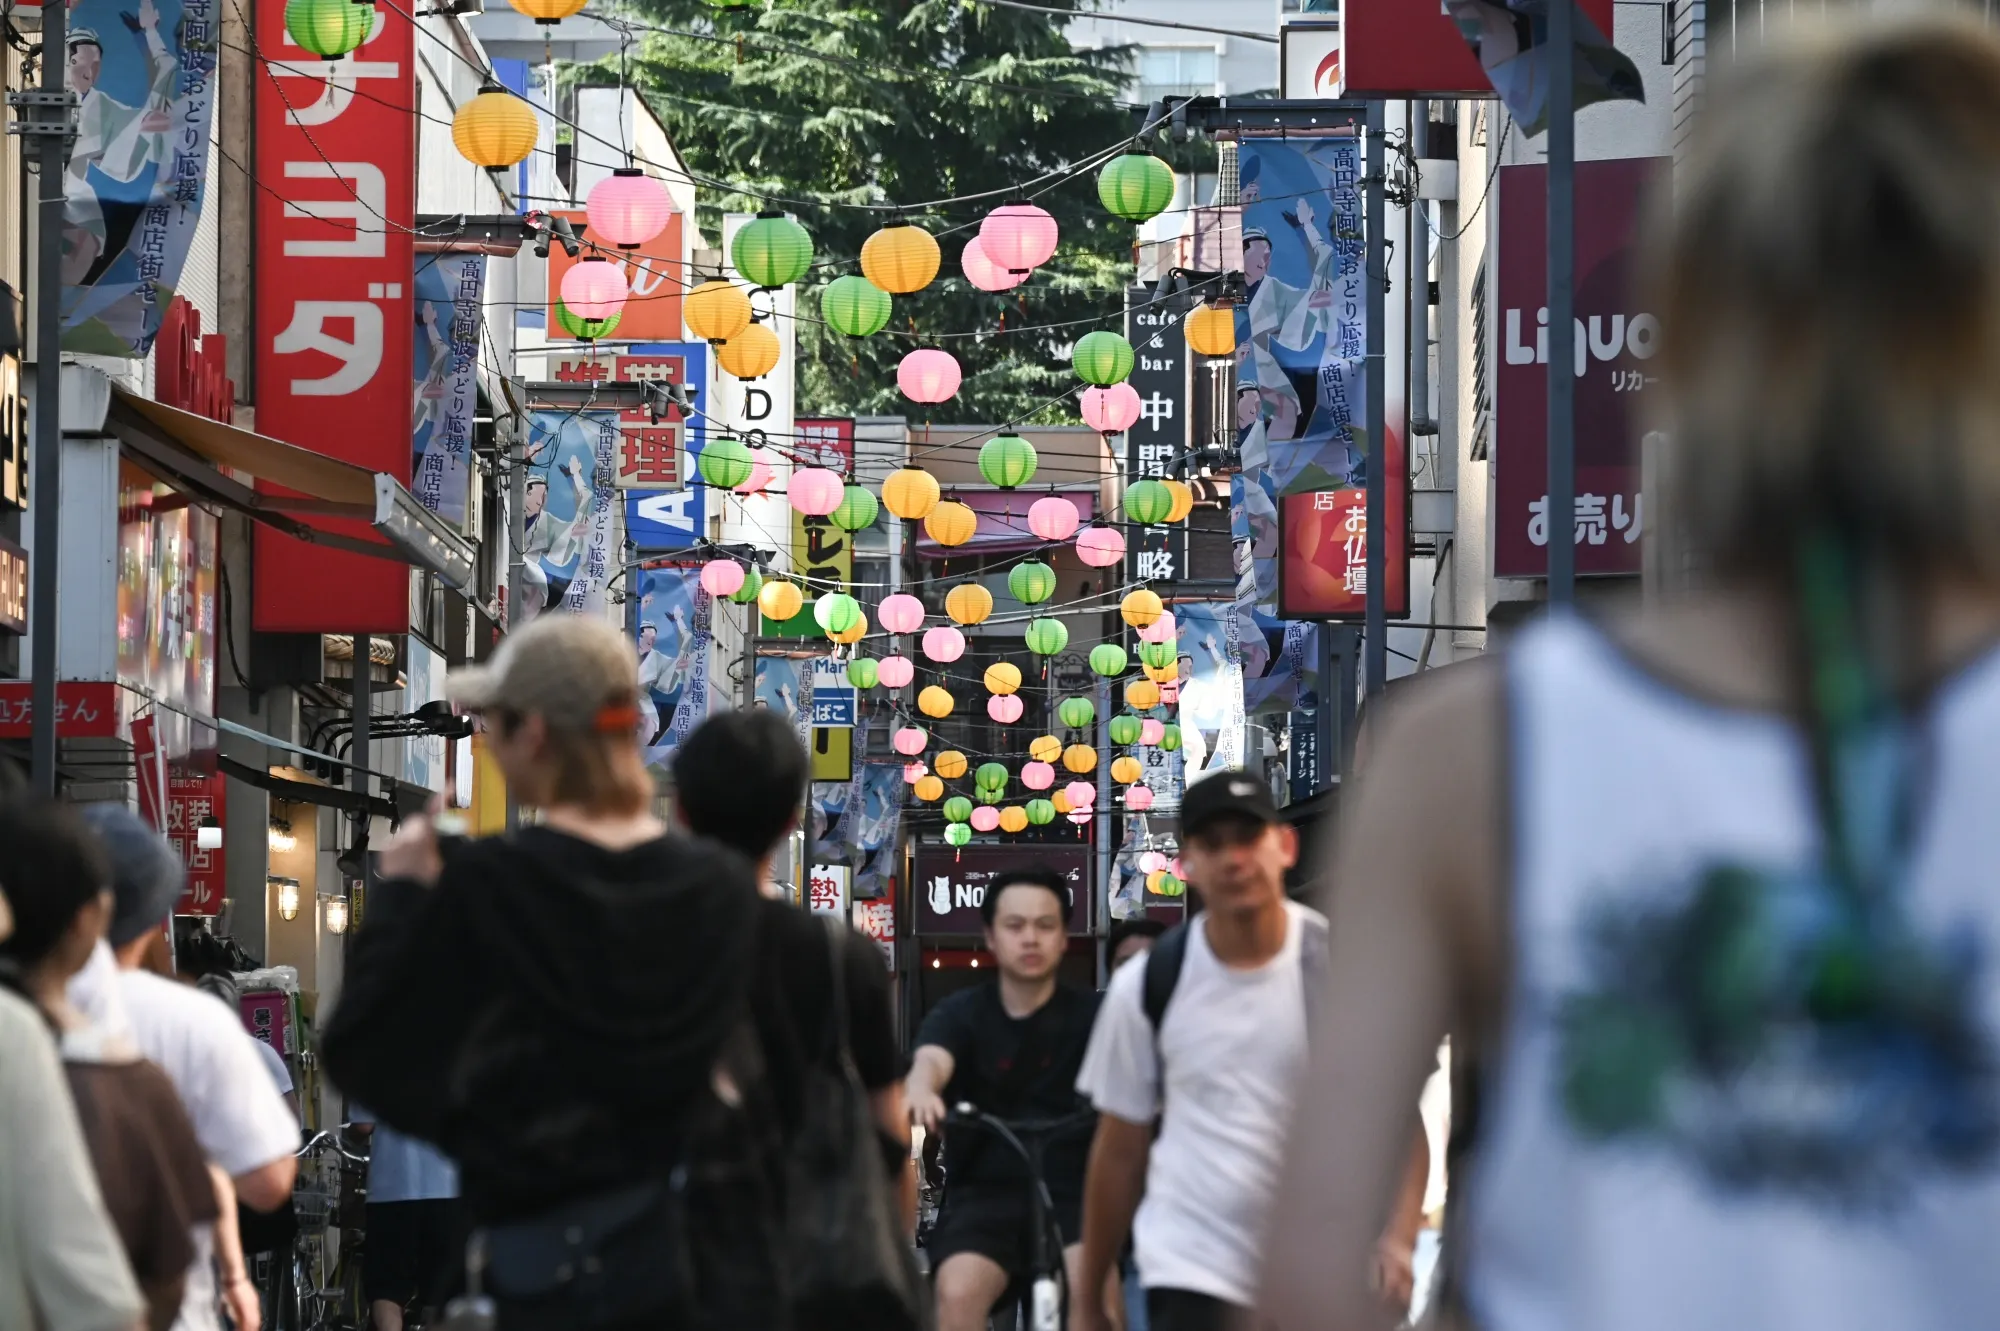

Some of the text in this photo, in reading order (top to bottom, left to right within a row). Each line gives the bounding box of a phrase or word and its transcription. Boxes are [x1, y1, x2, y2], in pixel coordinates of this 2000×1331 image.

[132, 204, 171, 352] 商店街セール
[1334, 147, 1362, 378] 高円寺阿波おどり応援！
[445, 260, 481, 471] 高円寺阿波おどり応援！
[1141, 355, 1174, 371] bar
[1149, 332, 1165, 349] &
[1322, 363, 1359, 484] 商店街セール
[588, 418, 616, 594] 高円寺阿波おどり応援！
[811, 704, 846, 722] ばこ
